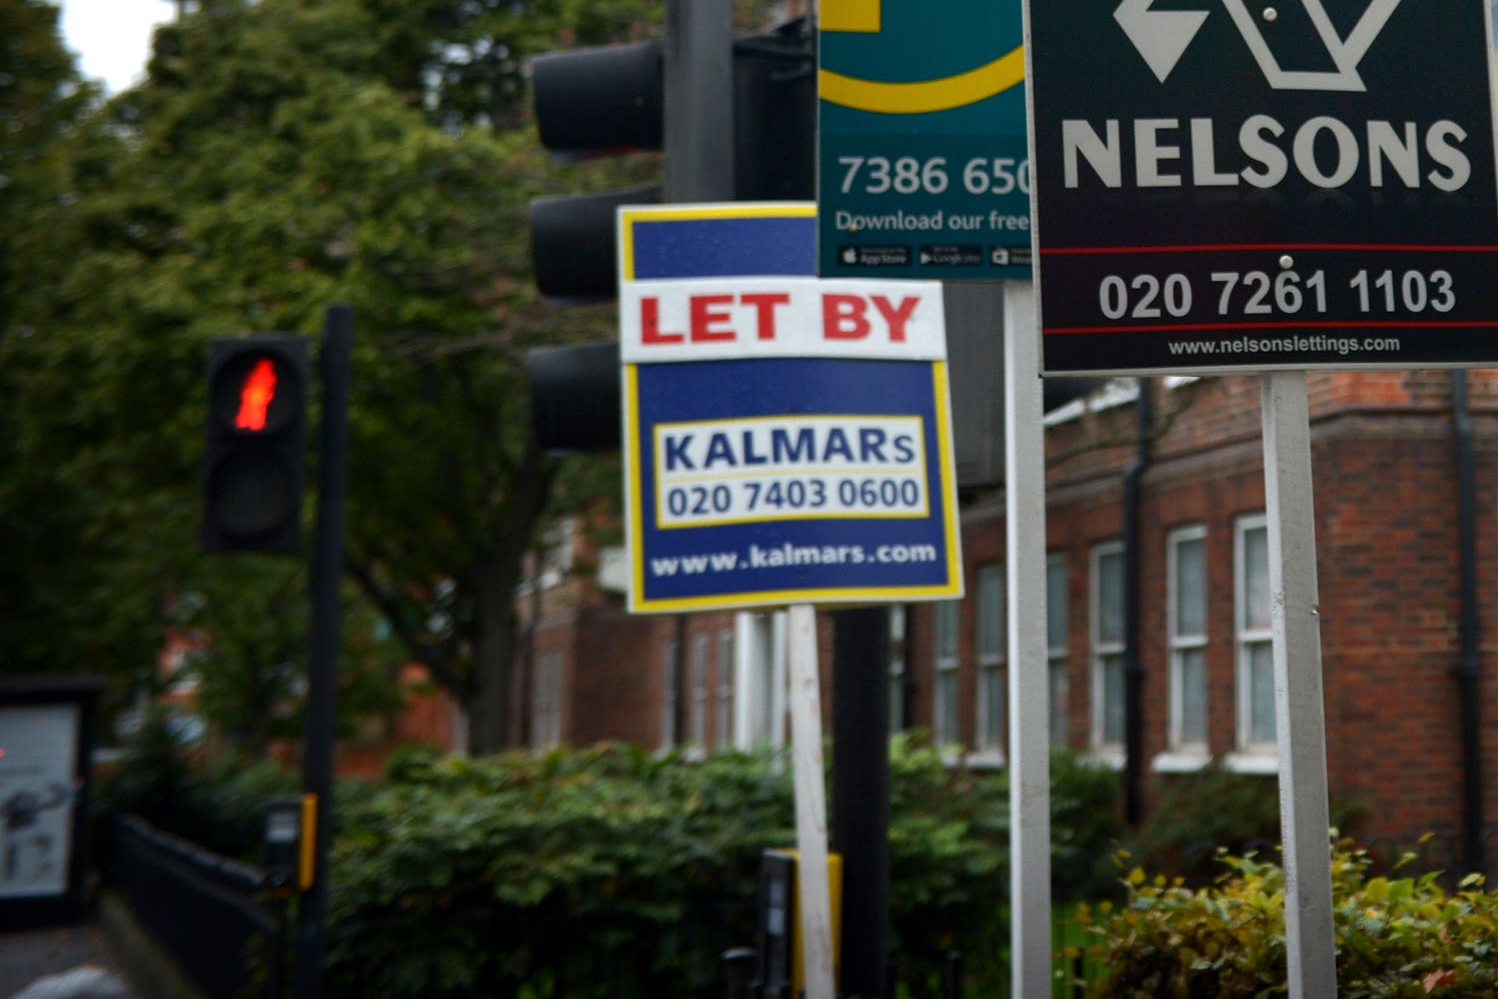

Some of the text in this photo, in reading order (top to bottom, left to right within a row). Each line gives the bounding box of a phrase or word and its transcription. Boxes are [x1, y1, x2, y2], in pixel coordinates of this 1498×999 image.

[1062, 114, 1472, 192] NELSONS
[838, 156, 948, 195] 7386
[836, 210, 1030, 231] Download our free
[1100, 269, 1456, 319] 020 7261 1103
[639, 292, 922, 346] LET BY
[1169, 334, 1400, 356] www.nelsonslettings.com
[668, 479, 919, 516] 020 7403 0600
[651, 543, 937, 577] www.kalmars.com
